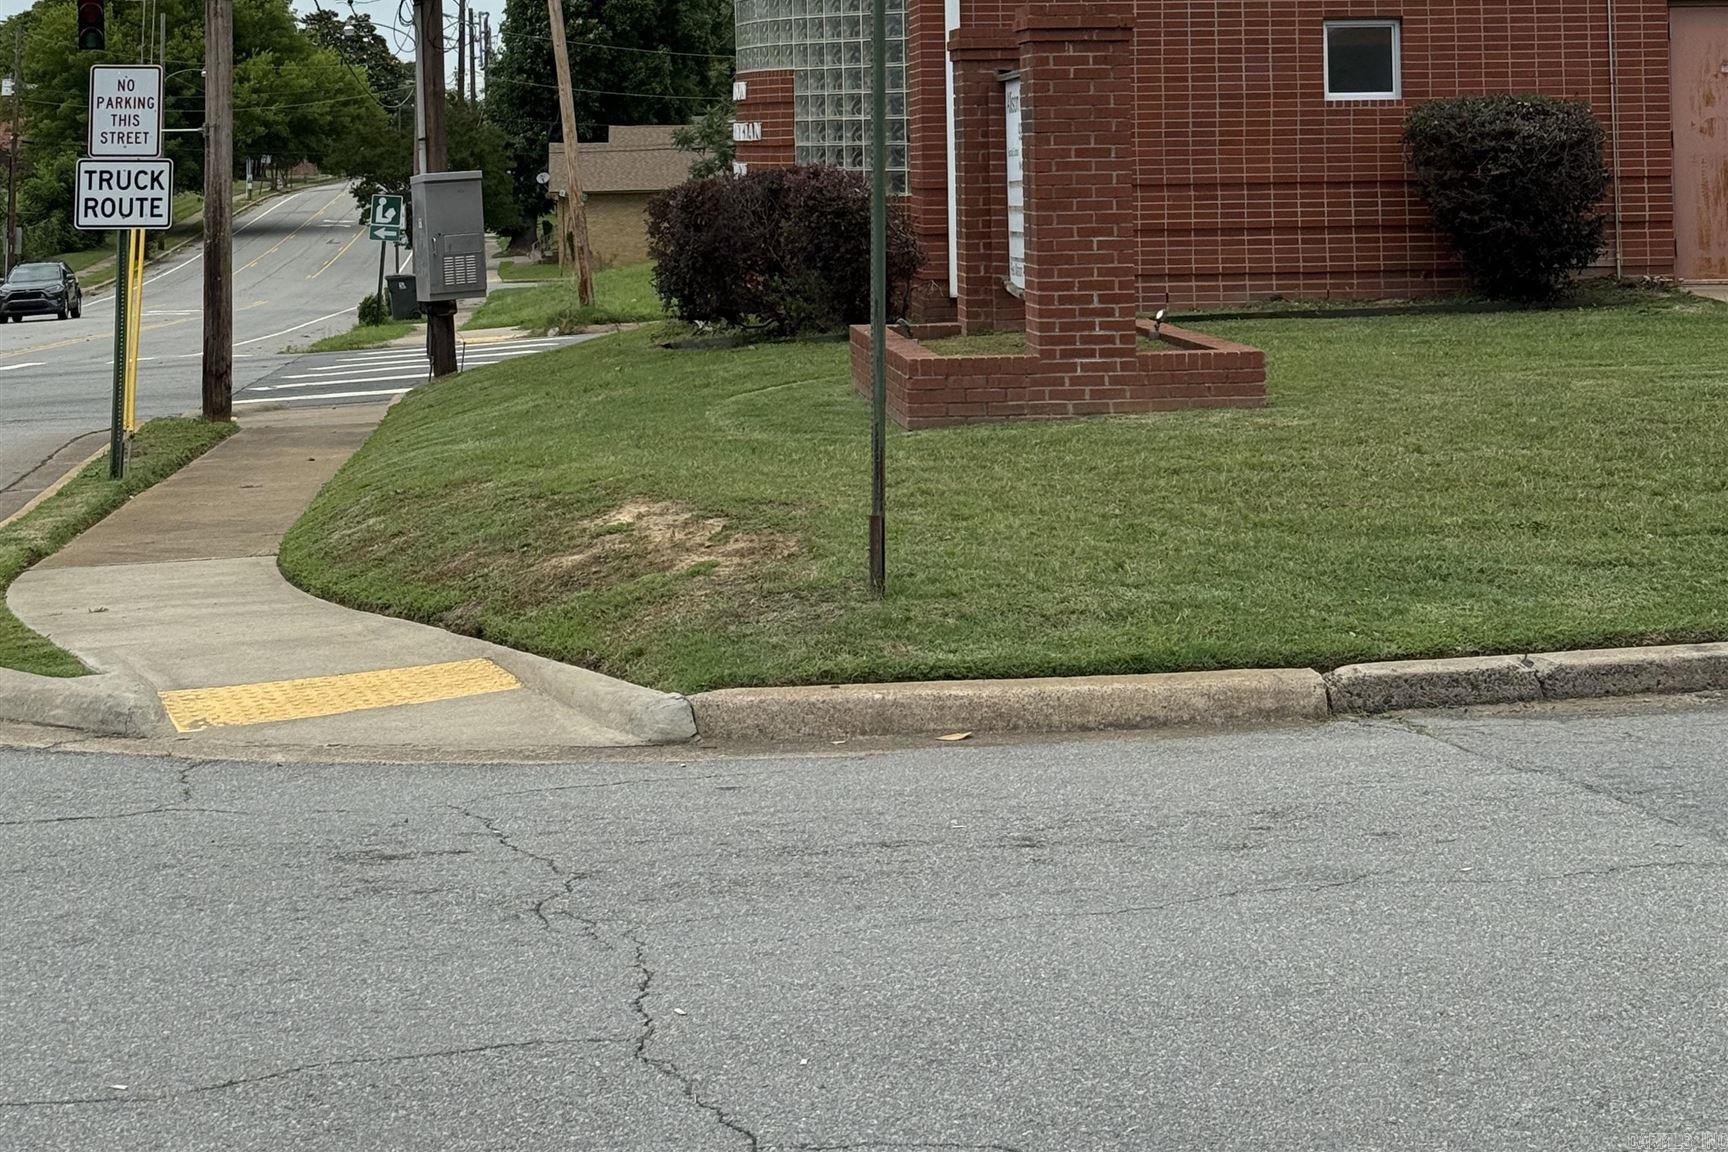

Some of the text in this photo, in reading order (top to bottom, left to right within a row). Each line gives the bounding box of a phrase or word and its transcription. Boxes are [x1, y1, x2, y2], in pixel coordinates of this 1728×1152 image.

[117, 79, 135, 92] NO
[96, 96, 156, 110] PARKING
[110, 114, 140, 127] THIS
[100, 131, 150, 145] STREET
[84, 169, 165, 191] TRUCK
[83, 197, 164, 219] ROUTE
